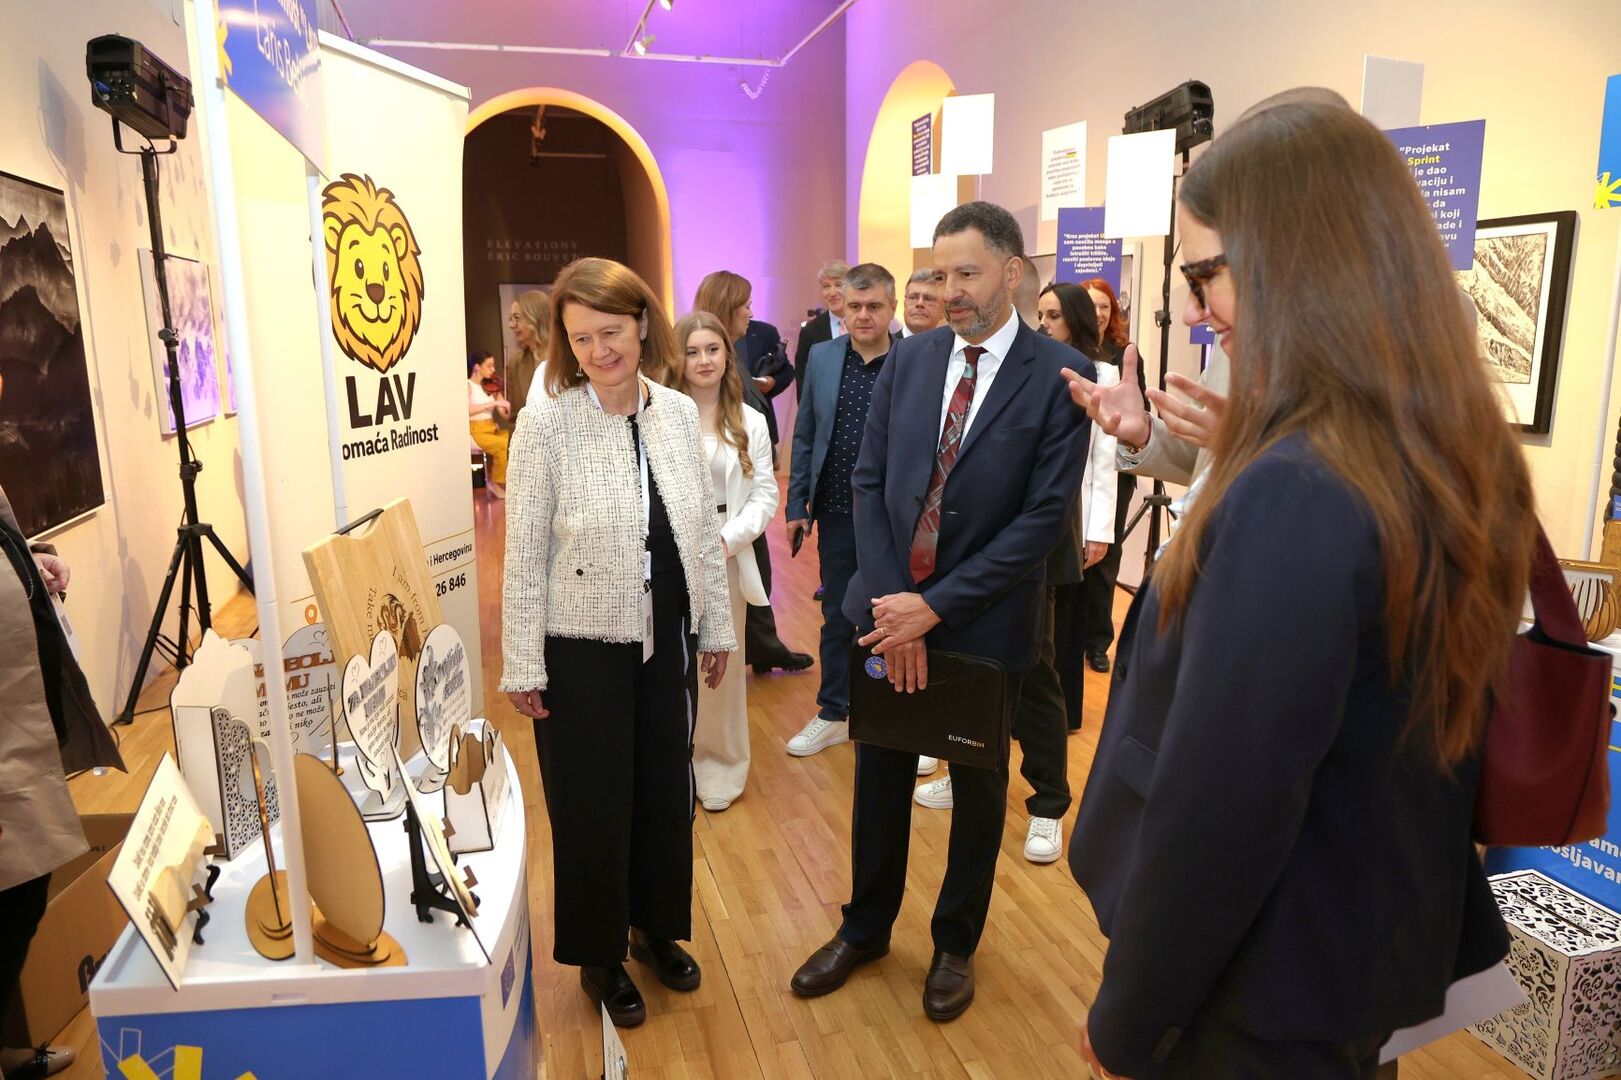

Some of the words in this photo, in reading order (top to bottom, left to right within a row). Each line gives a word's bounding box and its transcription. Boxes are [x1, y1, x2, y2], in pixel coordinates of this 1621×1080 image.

[1400, 143, 1450, 155] "Projekat
[1407, 155, 1441, 167] Sprint
[1414, 167, 1424, 178] je
[1426, 166, 1447, 176] dao
[1417, 176, 1448, 188] vaciju
[1450, 176, 1454, 184] i
[1433, 188, 1466, 197] nisam
[1432, 199, 1446, 208] da
[1440, 209, 1461, 220] koji
[1436, 220, 1456, 230] ade
[1458, 219, 1463, 229] i
[1440, 232, 1458, 240] ovu
[345, 372, 416, 429] LAV
[342, 431, 390, 460] omaća
[390, 424, 439, 450] Radinost
[433, 543, 473, 565] Hercegovina
[449, 573, 466, 591] 846
[311, 682, 337, 696] zauzti
[311, 695, 322, 704] ali
[295, 710, 305, 719] ne
[306, 704, 325, 716] može
[295, 718, 313, 730] niko
[948, 734, 985, 748] EUFORBIH
